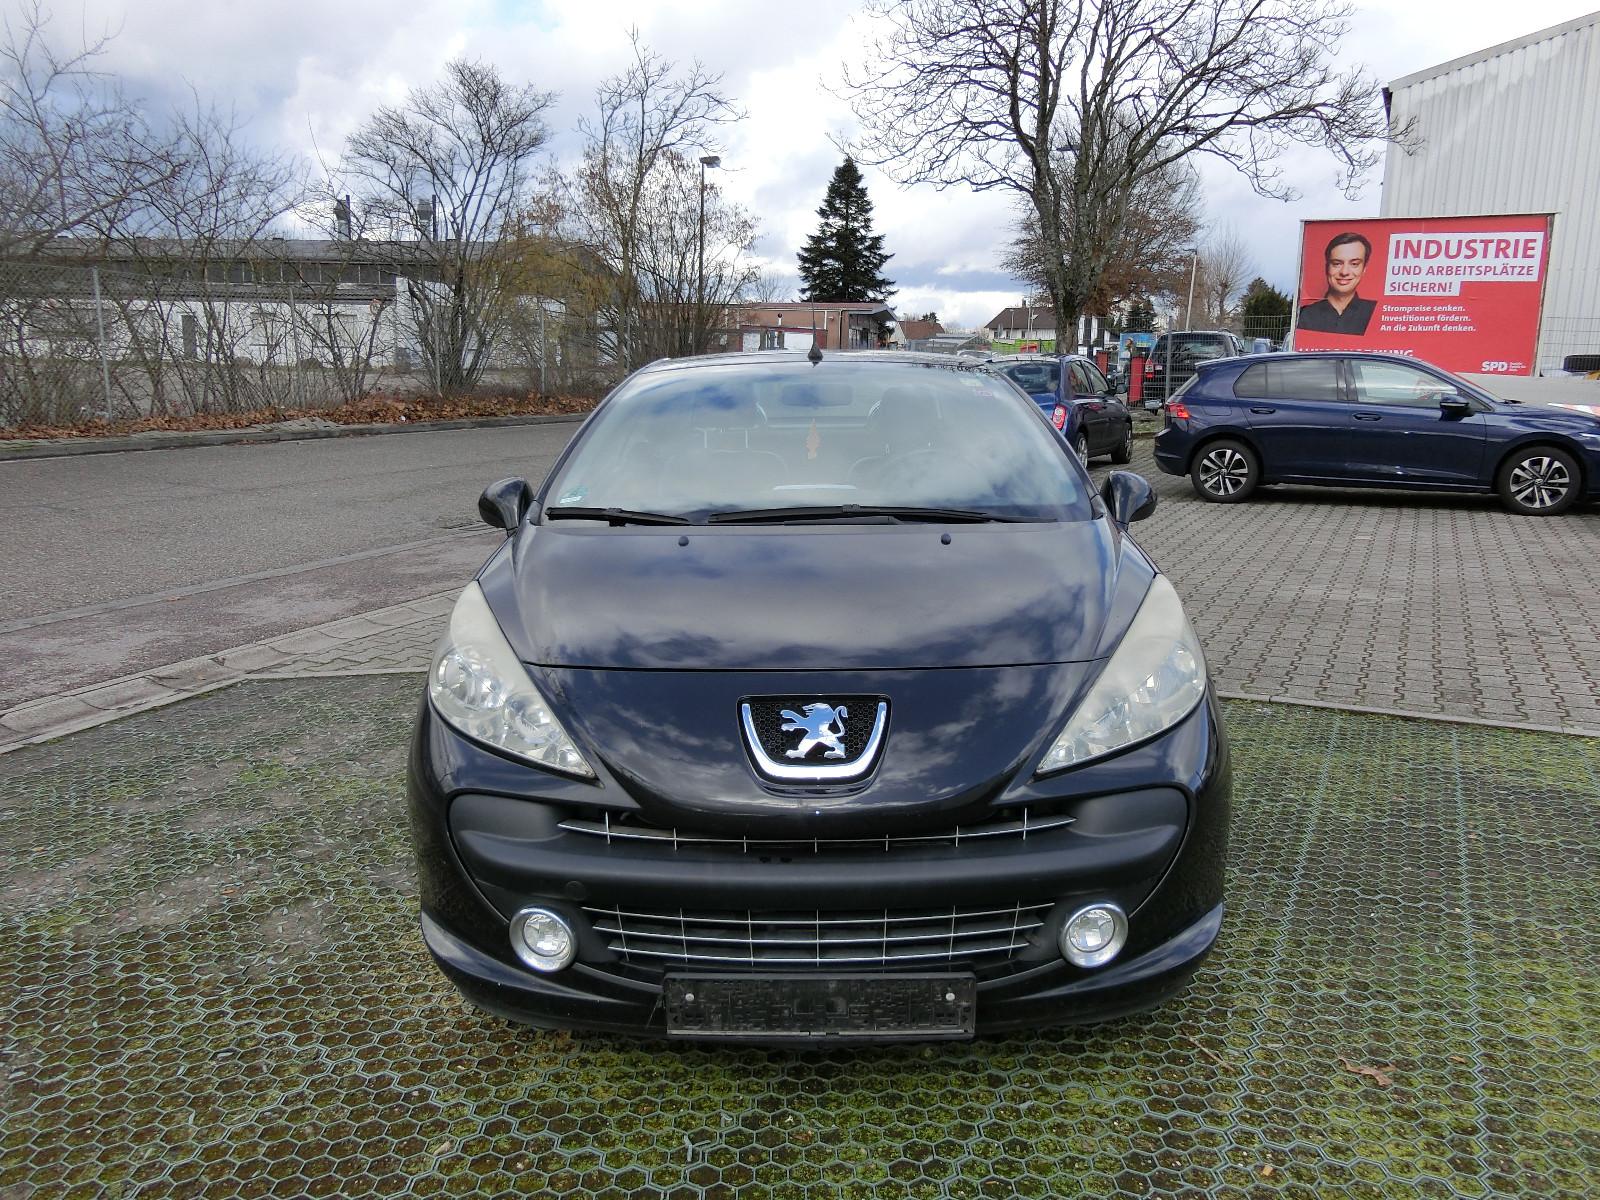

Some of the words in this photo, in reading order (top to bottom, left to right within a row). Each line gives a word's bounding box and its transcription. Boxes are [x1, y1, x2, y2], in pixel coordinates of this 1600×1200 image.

[1394, 239, 1538, 259] INDUSTRIE
[1391, 265, 1422, 276] UND
[1425, 263, 1536, 276] ARBEITSPLÄTZE
[1390, 281, 1453, 293] SICHERN!
[1382, 304, 1431, 313] Strompreise
[1433, 304, 1466, 312] senken.
[1381, 314, 1435, 322] Investitionen
[1437, 314, 1471, 322] fördern.
[1380, 324, 1391, 332] An
[1393, 324, 1406, 332] die
[1408, 324, 1440, 332] Zukunft
[1442, 324, 1476, 332] denken.
[1481, 361, 1508, 372] SPD
